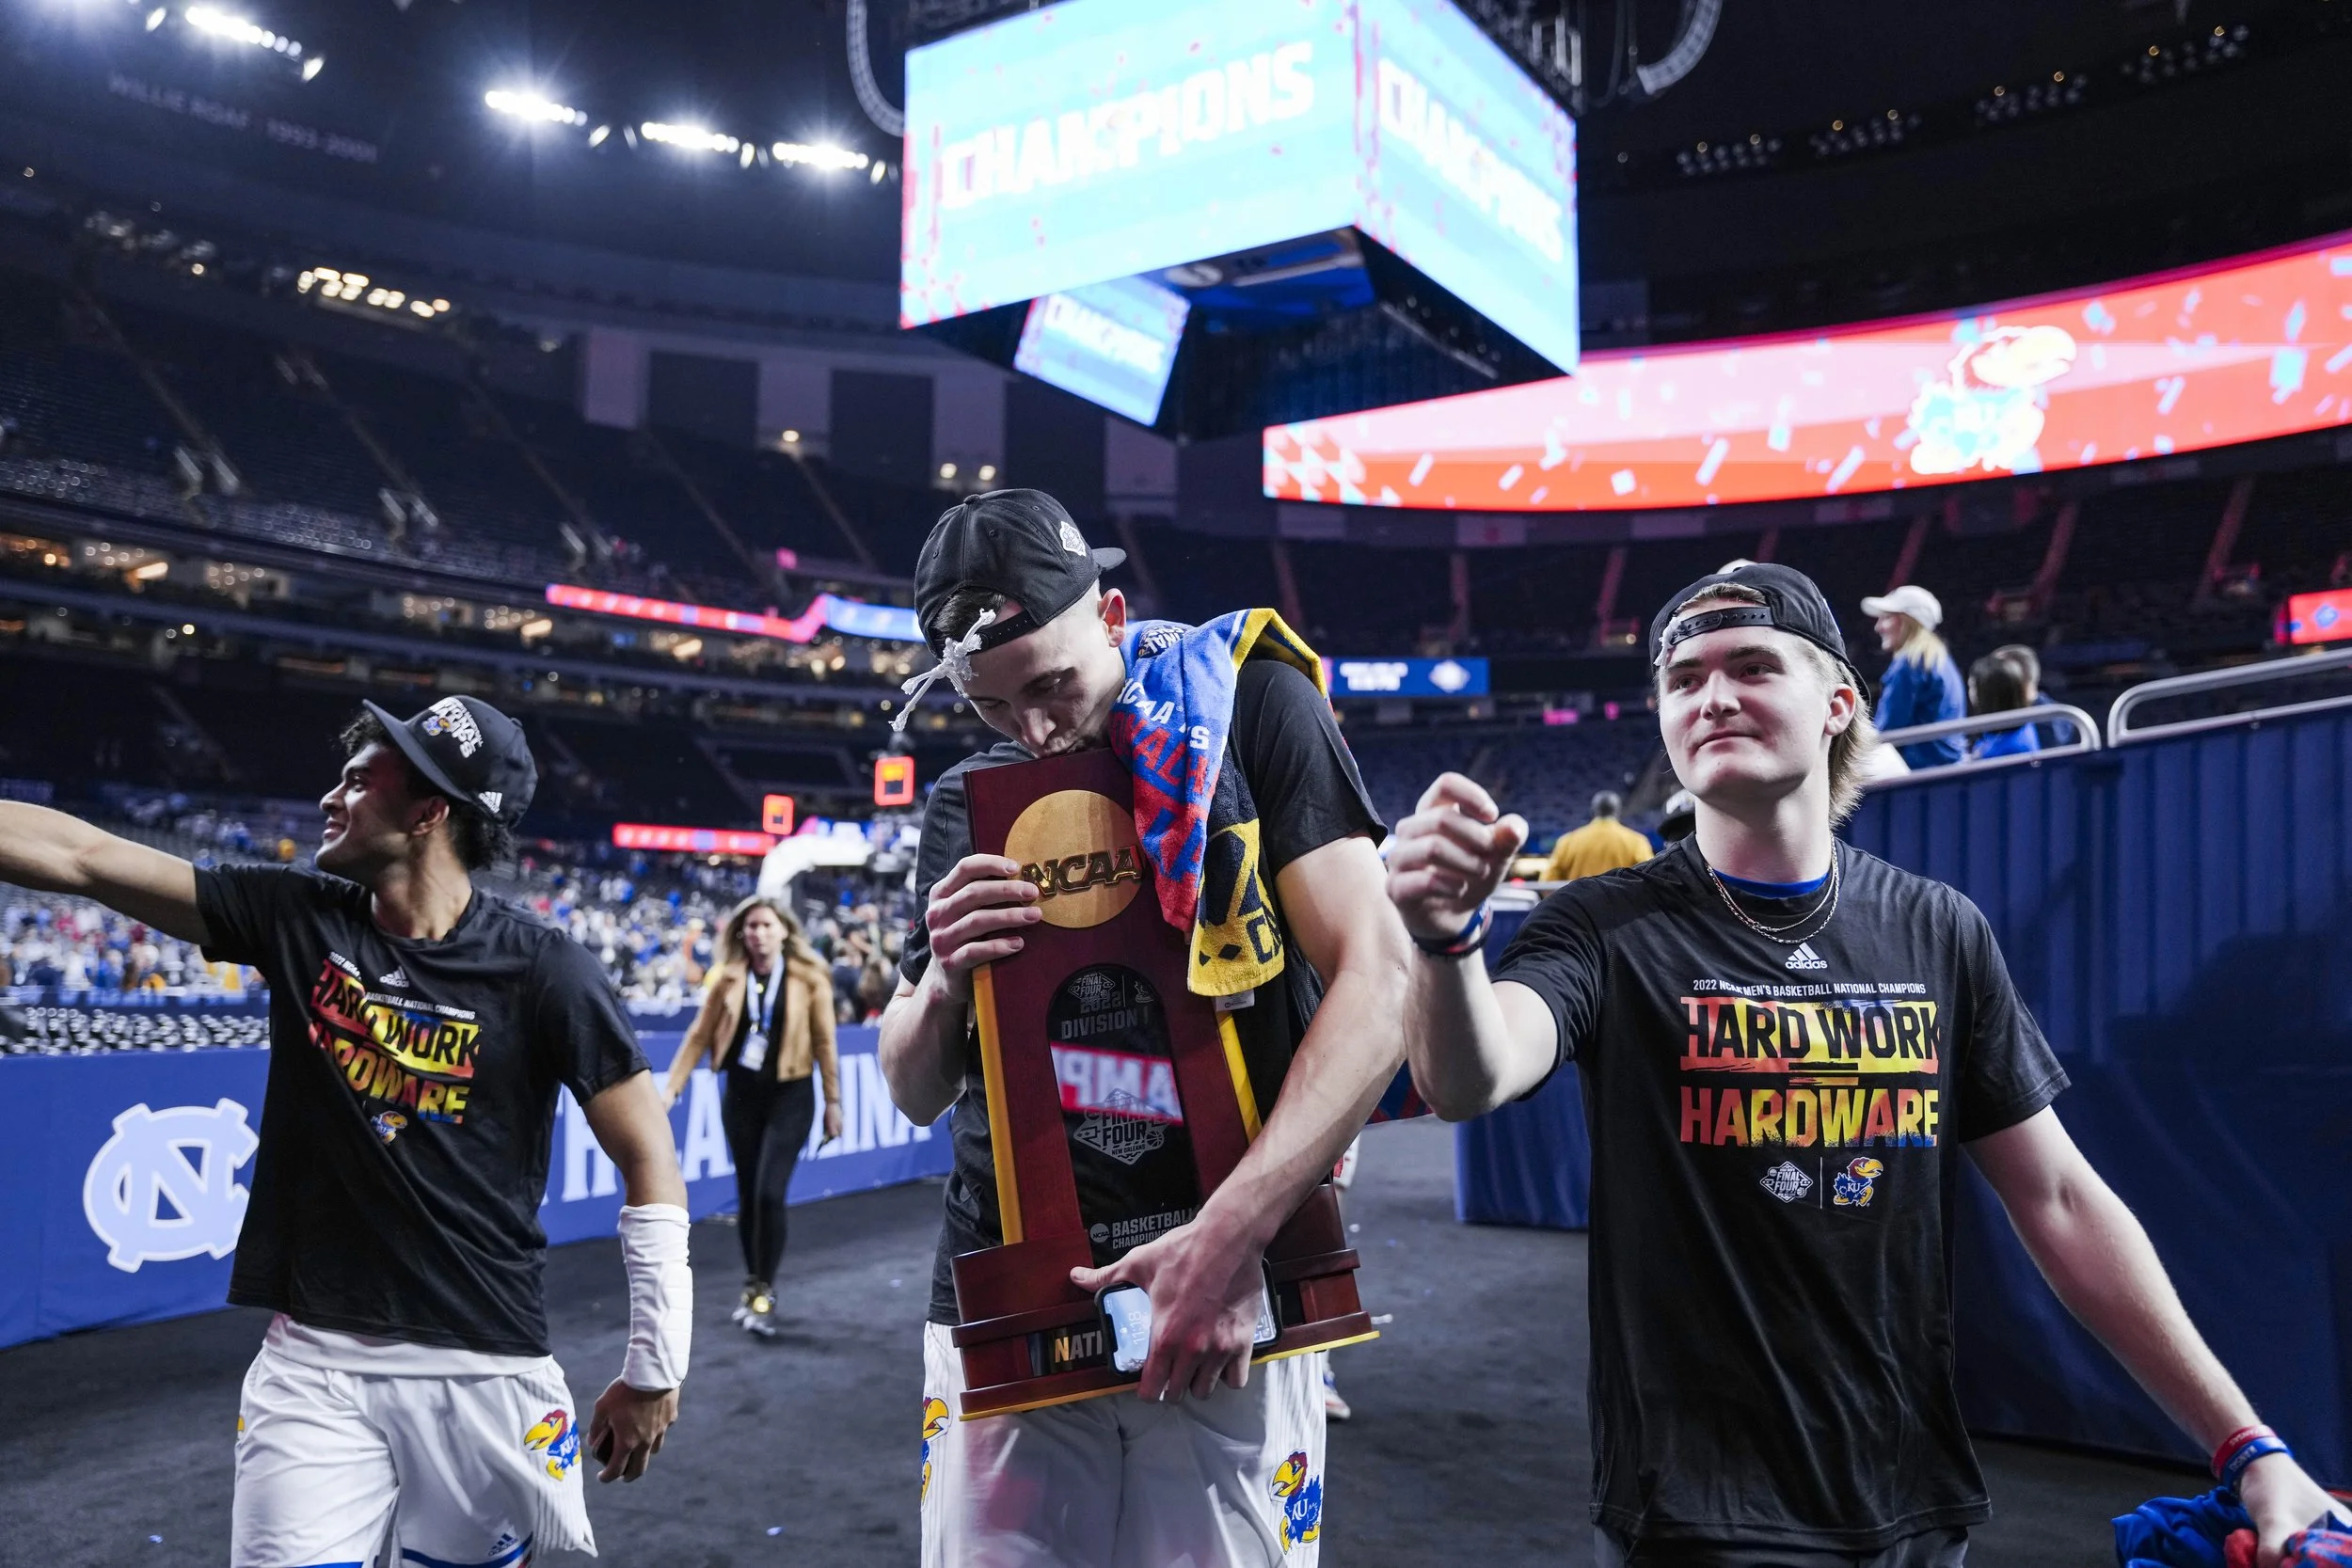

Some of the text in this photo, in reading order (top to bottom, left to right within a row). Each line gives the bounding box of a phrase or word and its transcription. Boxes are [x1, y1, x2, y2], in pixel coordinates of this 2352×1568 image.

[942, 41, 1314, 209] CHAMPIONS
[1022, 847, 1142, 895] NCAA
[1786, 958, 1828, 970] adidas
[1693, 979, 1717, 991] 2022
[1744, 984, 1772, 995] MEN'S
[1773, 983, 1832, 997] BASKETBALL
[1835, 983, 1877, 995] NATIONAL
[1878, 983, 1926, 994] CHAMPIONS
[436, 1005, 476, 1021] CHAMPIONS
[1061, 1008, 1138, 1040] DIVISION
[383, 1013, 480, 1069] WORK
[1689, 1004, 1940, 1060] HARD WORK
[1680, 1085, 1939, 1148] HARDWARE
[1102, 1121, 1147, 1148] FOUR
[1111, 1144, 1146, 1156] NEW ORLEANS
[1773, 1180, 1800, 1193] FOUR
[1776, 1171, 1801, 1181] FINAL
[1847, 1182, 1861, 1193] KU
[1055, 1330, 1104, 1363] NATI
[1292, 1498, 1309, 1521] KU
